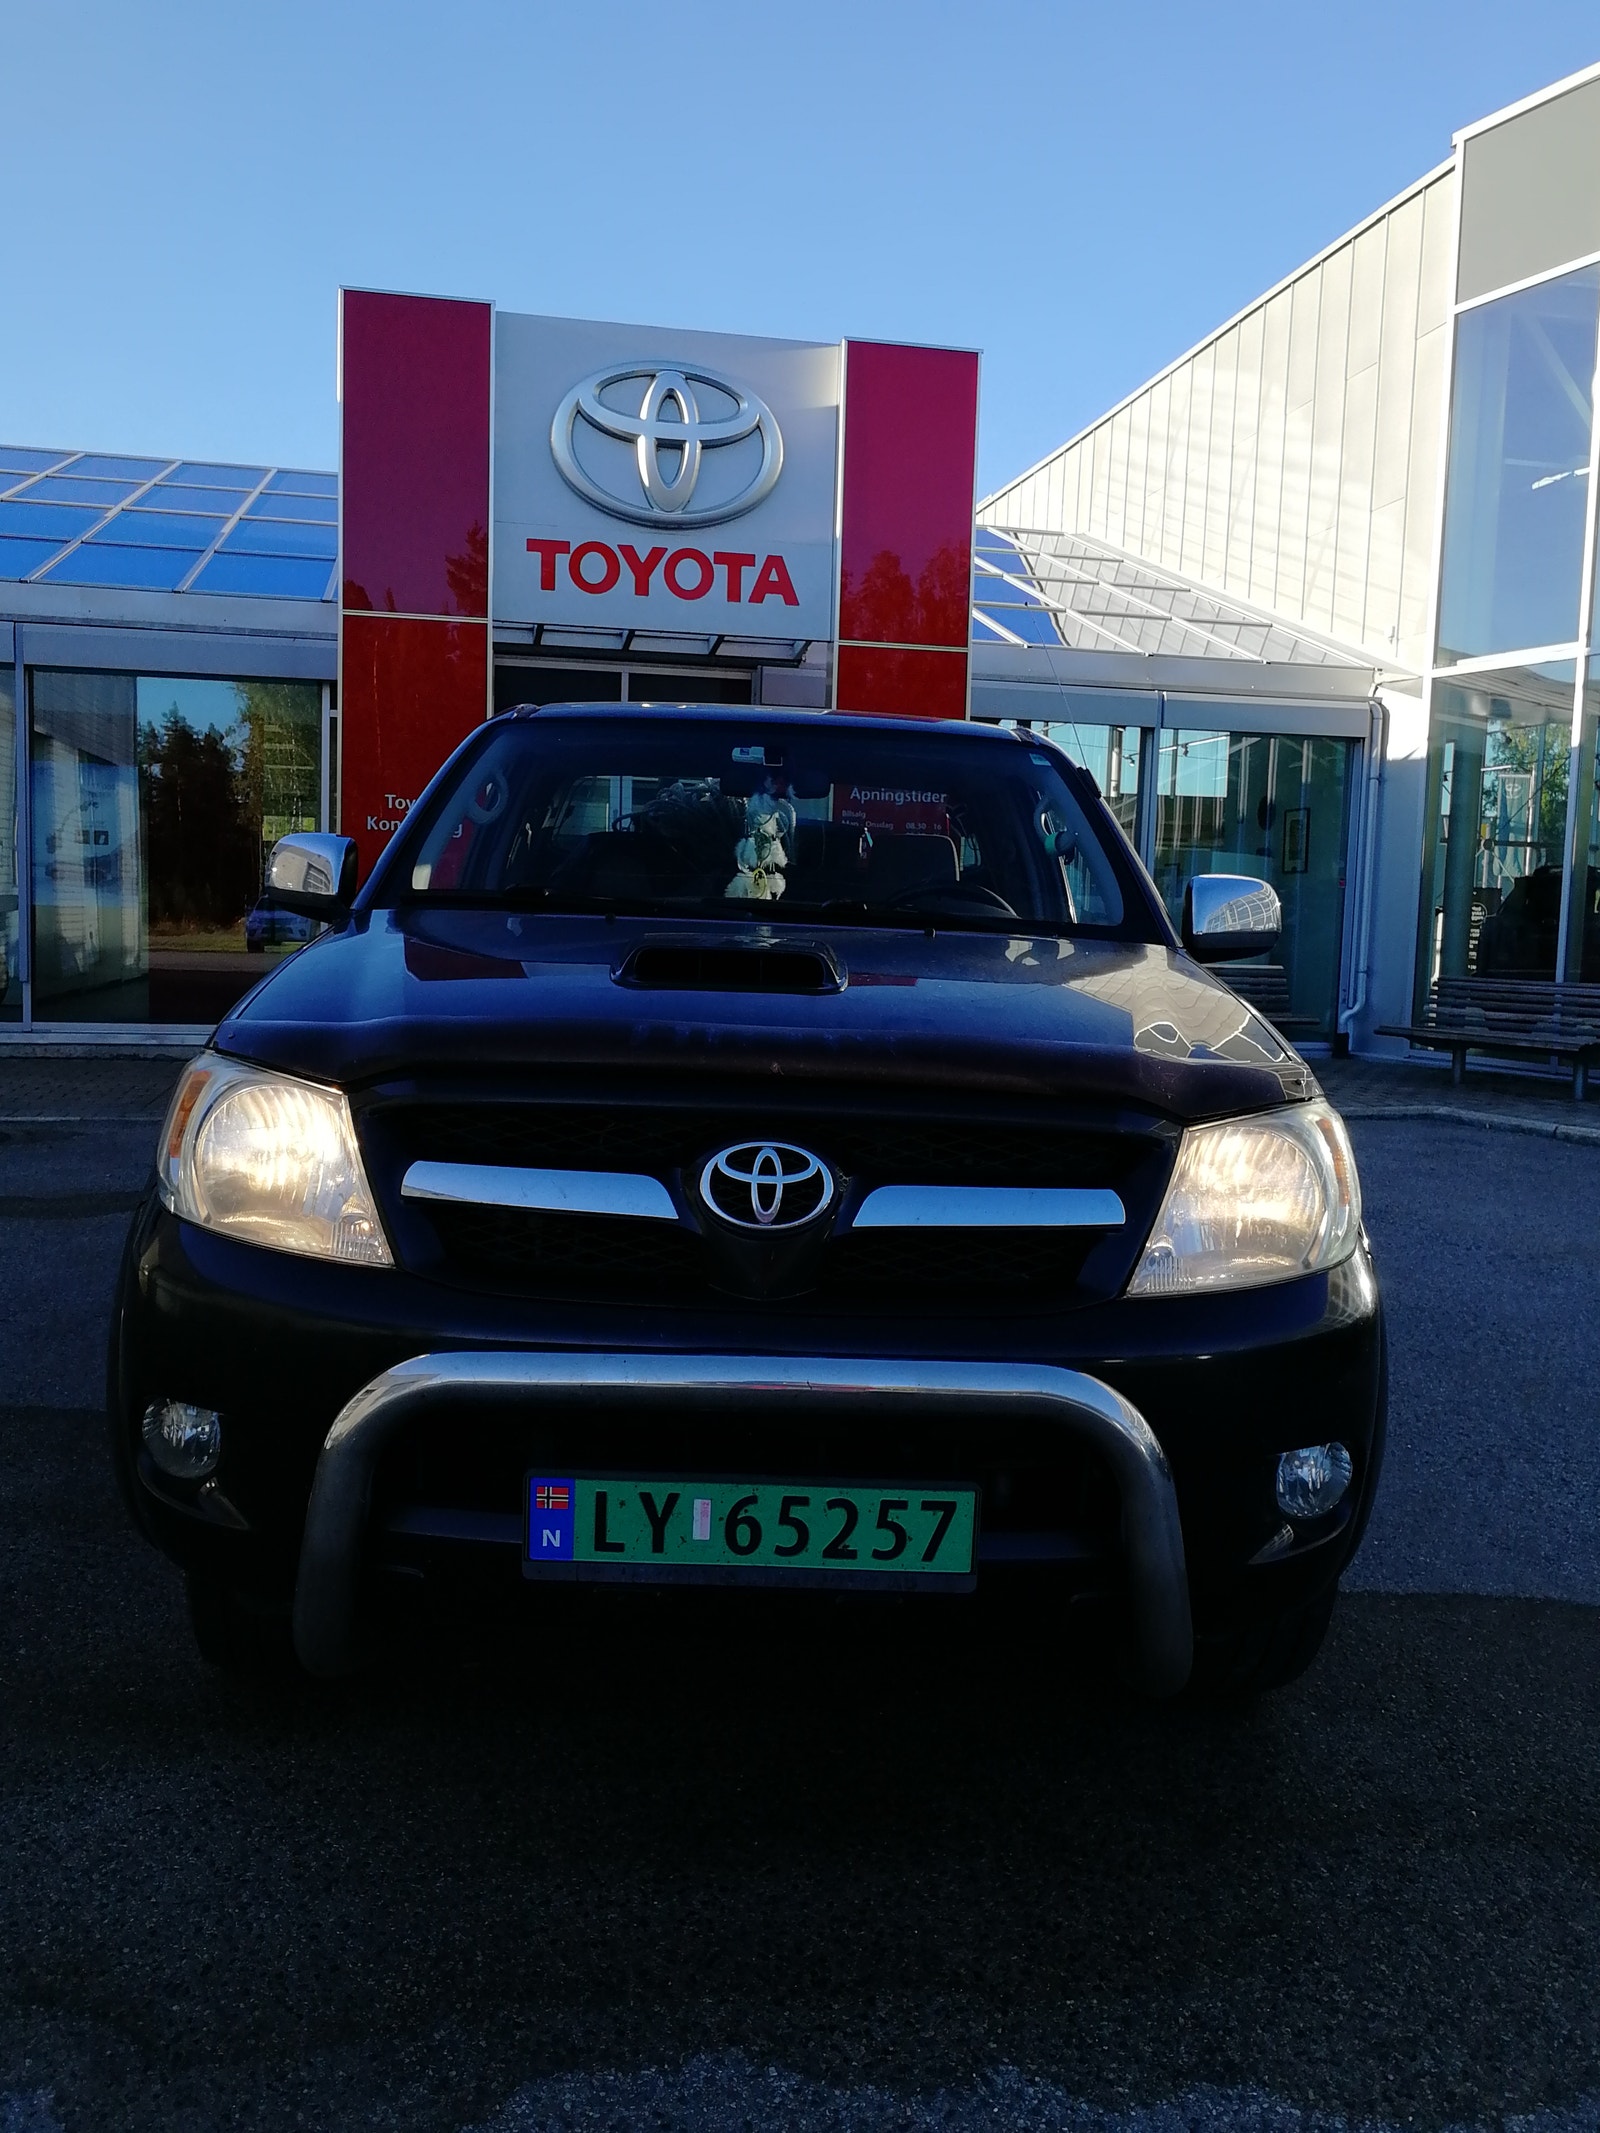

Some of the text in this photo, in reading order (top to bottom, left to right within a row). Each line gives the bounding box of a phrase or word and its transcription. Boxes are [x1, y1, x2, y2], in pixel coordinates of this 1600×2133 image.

[526, 538, 800, 606] TOYOTA
[384, 794, 416, 813] Toy
[542, 1529, 561, 1547] N
[594, 1491, 957, 1563] LY 65257
